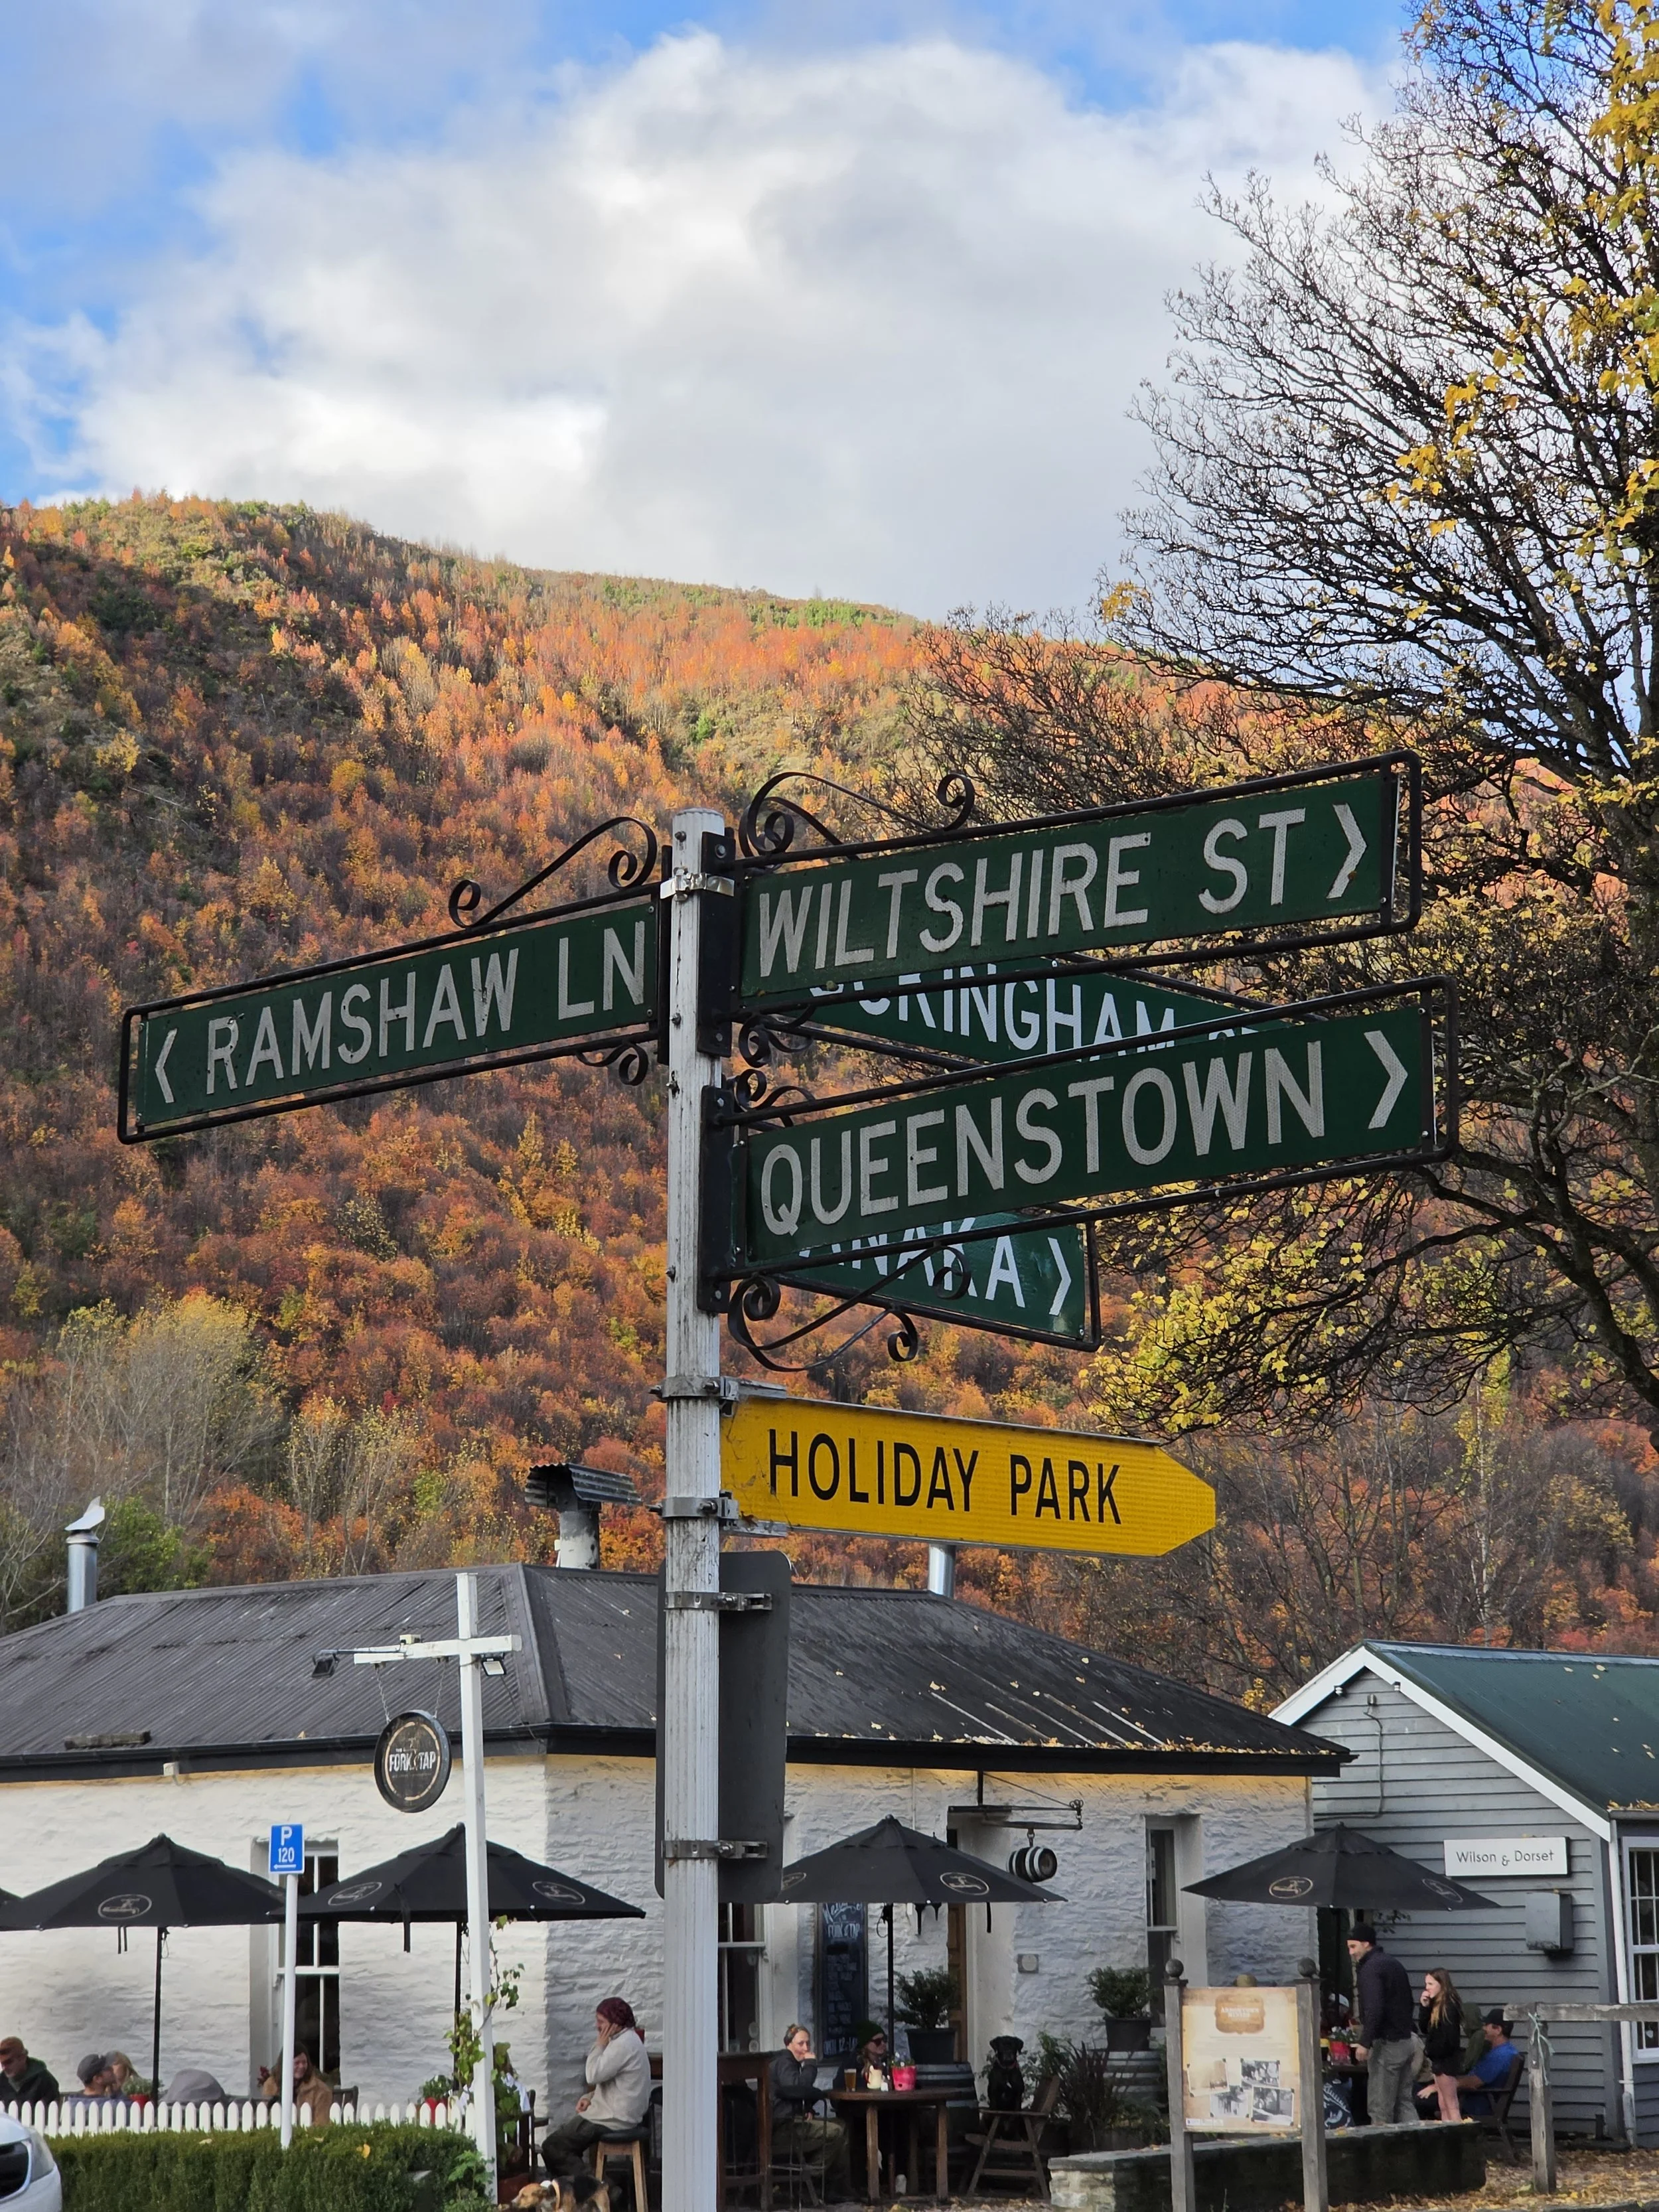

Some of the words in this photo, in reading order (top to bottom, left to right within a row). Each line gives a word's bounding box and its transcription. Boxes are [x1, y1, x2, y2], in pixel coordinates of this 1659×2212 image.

[759, 832, 1151, 978] WILTSHIRE
[1198, 808, 1306, 915] ST
[206, 947, 520, 1094] RAMSHAW
[557, 920, 647, 1021] LN
[760, 1040, 1325, 1236] QUEENSTOWN
[768, 1428, 979, 1512] HOLIDAY
[1010, 1454, 1122, 1524] PARK
[389, 1753, 412, 1772] FORK
[418, 1751, 436, 1770] TAP
[278, 1847, 295, 1863] 120
[281, 1826, 292, 1846] P
[1457, 1851, 1496, 1863] Wilson
[1502, 1855, 1510, 1866] &
[1514, 1849, 1554, 1862] Dorset
